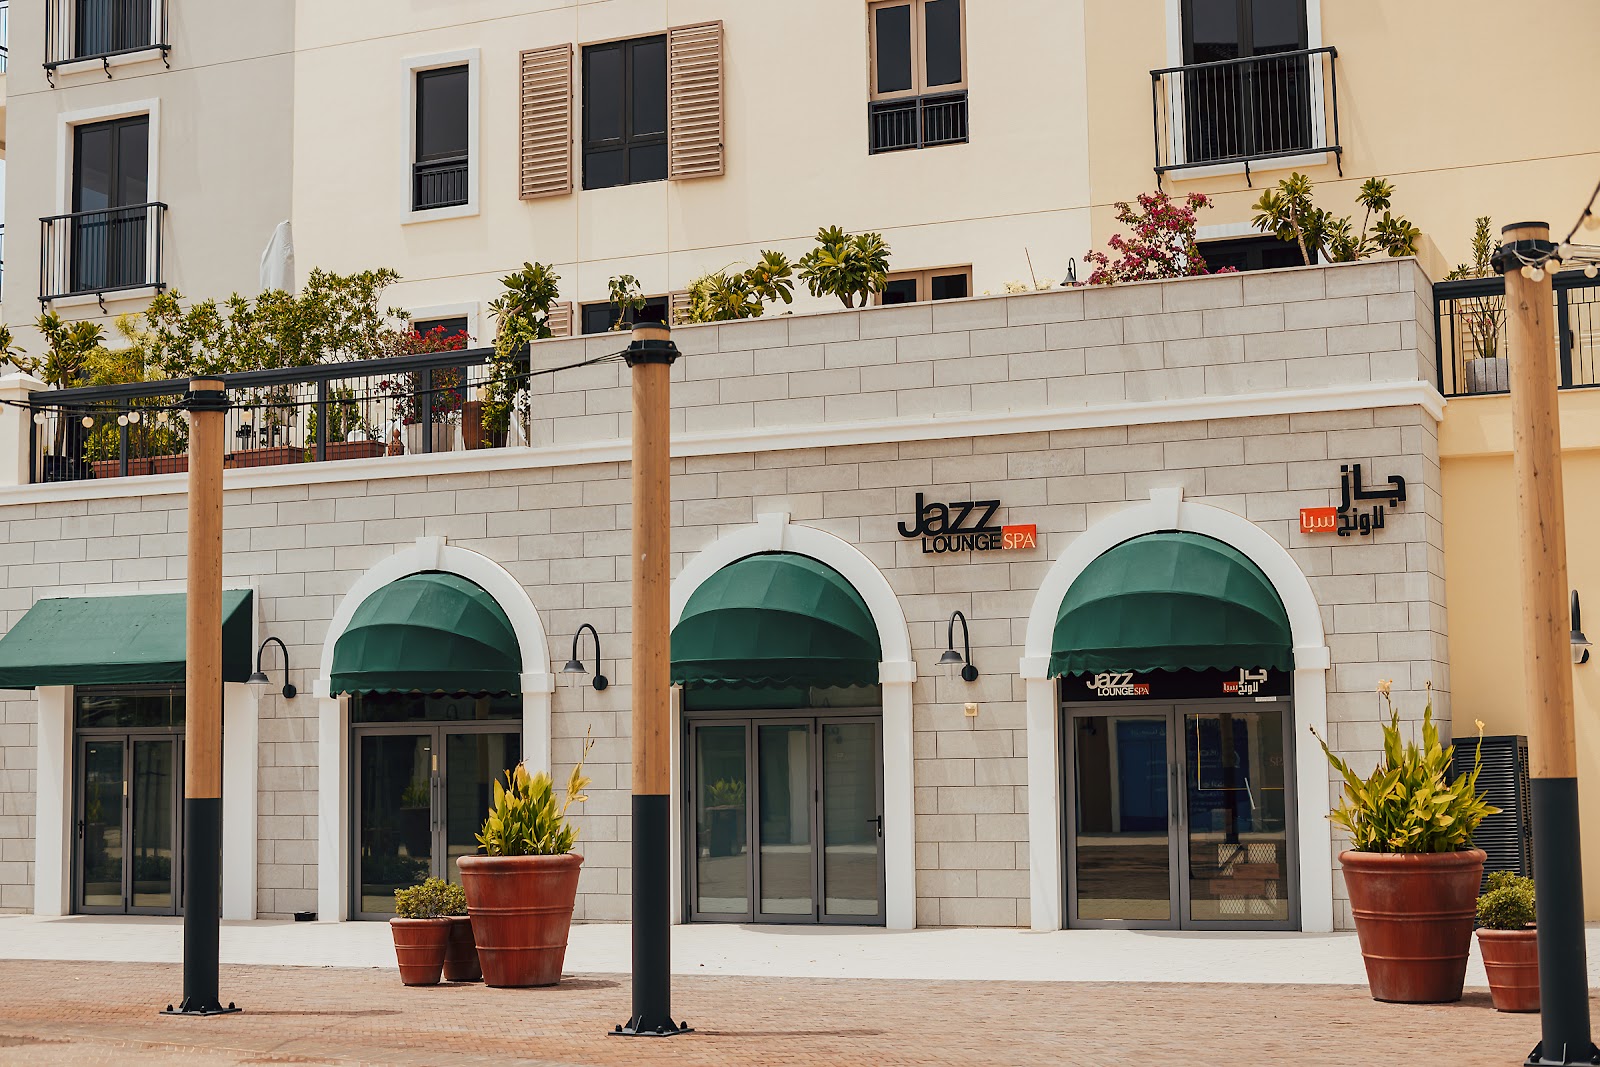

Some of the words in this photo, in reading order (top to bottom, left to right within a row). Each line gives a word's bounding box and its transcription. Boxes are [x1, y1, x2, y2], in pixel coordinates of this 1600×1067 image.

[1338, 463, 1406, 513] جاز
[897, 492, 1001, 538] Jazz
[1301, 511, 1335, 533] سبا
[922, 533, 1002, 553] LOUNGE
[1004, 532, 1036, 549] SPA
[1085, 672, 1134, 690] Jazz
[1097, 687, 1134, 697] LOUNGE
[1134, 687, 1150, 696] SPA
